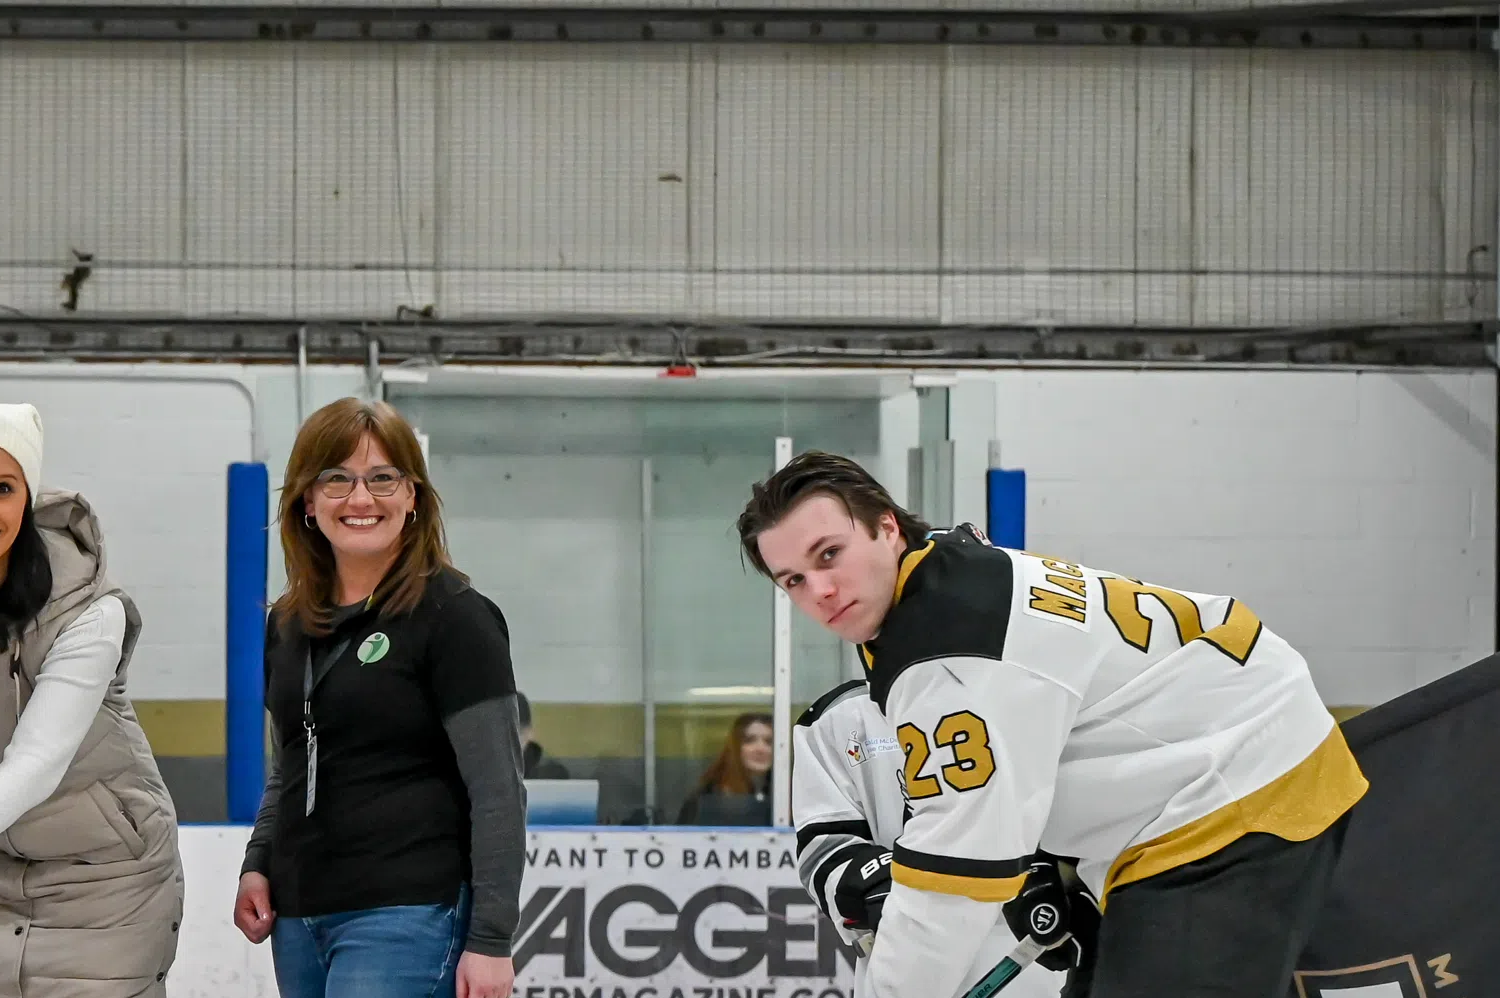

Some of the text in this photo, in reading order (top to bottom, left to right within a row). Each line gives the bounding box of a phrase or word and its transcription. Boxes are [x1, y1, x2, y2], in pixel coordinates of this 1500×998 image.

[1026, 552, 1086, 624] MAC
[896, 710, 996, 800] 23
[626, 848, 665, 869] TO
[683, 848, 795, 869] BAMBA
